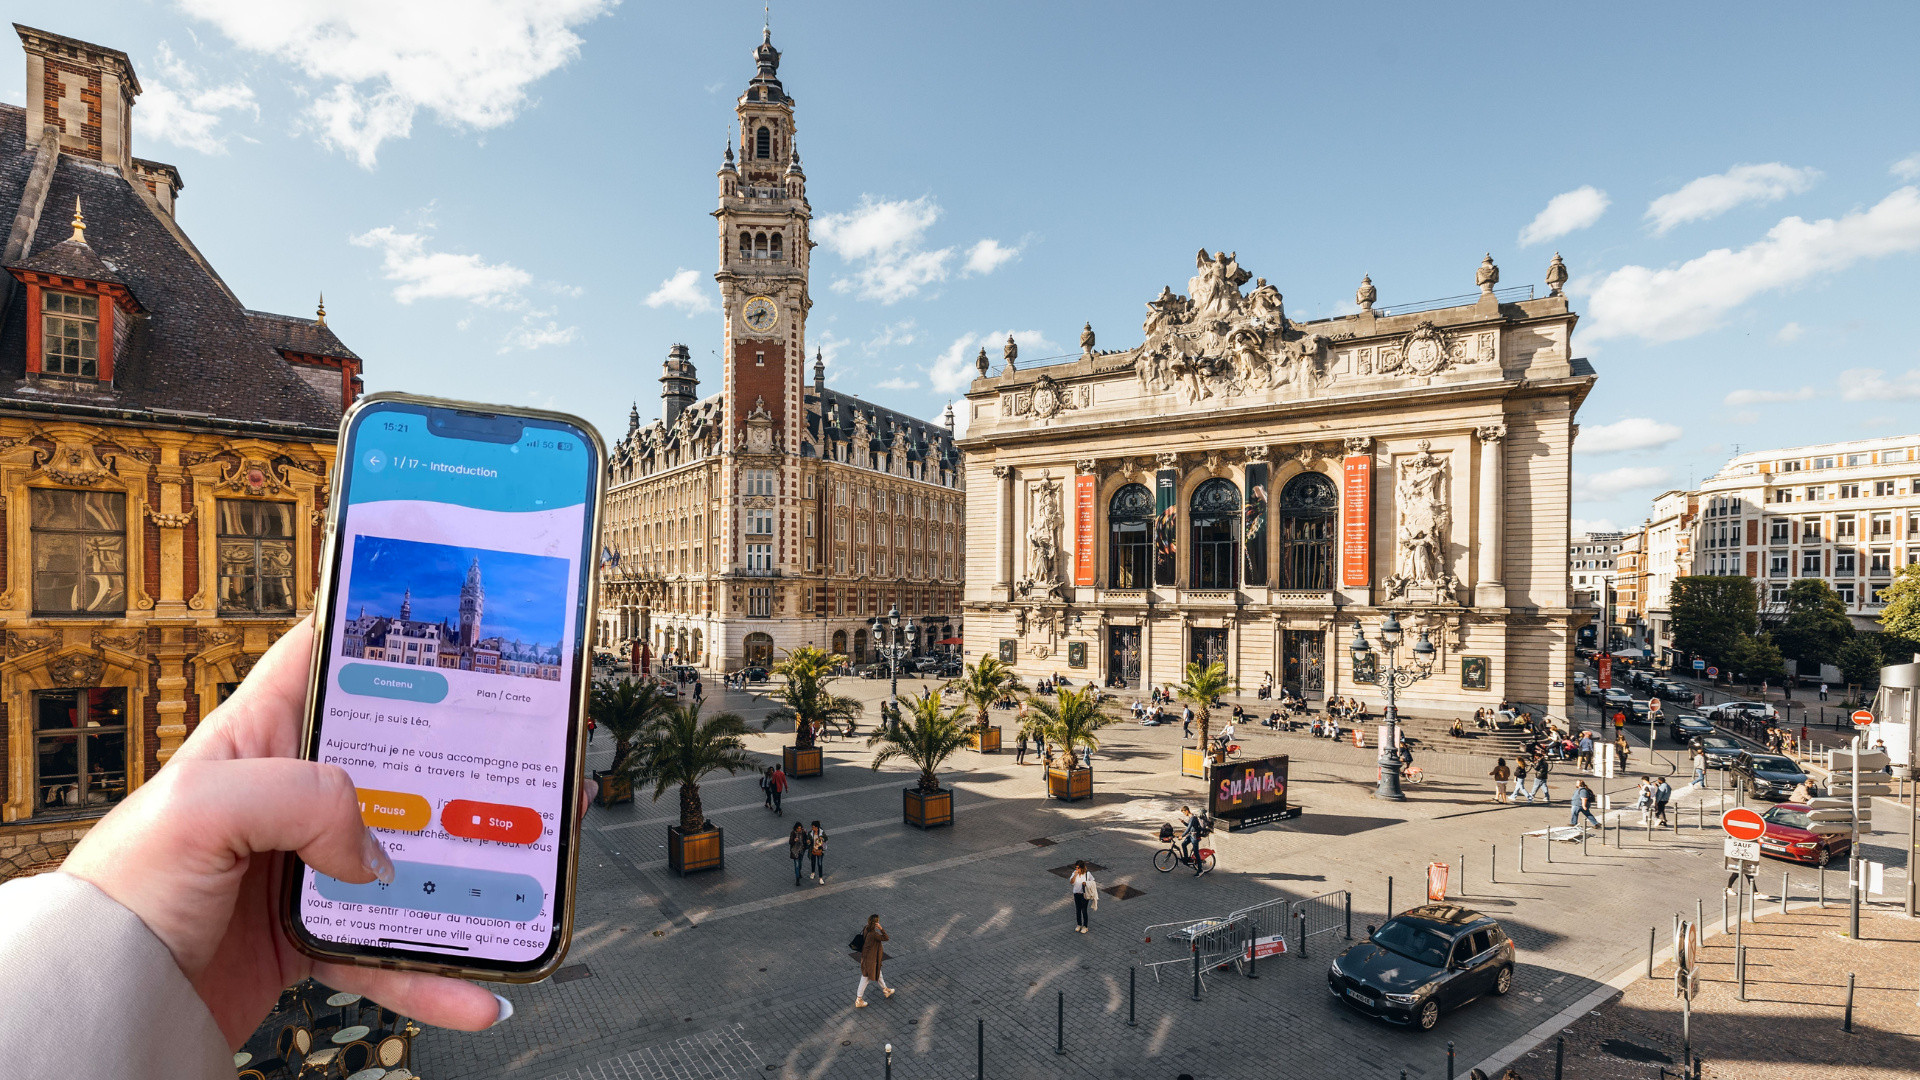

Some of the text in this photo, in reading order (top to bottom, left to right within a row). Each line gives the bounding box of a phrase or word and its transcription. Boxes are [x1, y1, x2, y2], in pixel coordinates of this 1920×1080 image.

[383, 422, 408, 433] 15:21
[542, 441, 554, 449] 5G
[393, 457, 398, 466] 1
[399, 456, 406, 469] /
[408, 458, 418, 469] 17
[430, 462, 498, 478] Introduction
[373, 677, 413, 689] Contenu
[477, 690, 531, 703] Plan / Carte
[330, 707, 432, 728] Bonjour, je suis Léa,
[326, 739, 558, 773] Aujourd'hui je ne vous accompagne pas en
[324, 755, 557, 789] personne, mais à travers le temps et les
[373, 804, 406, 816] Pause
[489, 817, 513, 831] Stop
[389, 842, 405, 852] ça.
[527, 842, 552, 852] vous
[307, 899, 333, 909] vous
[368, 906, 398, 916] sentir
[446, 914, 460, 923] du
[515, 922, 526, 930] et
[531, 923, 546, 932] du
[305, 915, 545, 949] pain, et vous montrer une ville qui ne cesse
[321, 934, 333, 942] se
